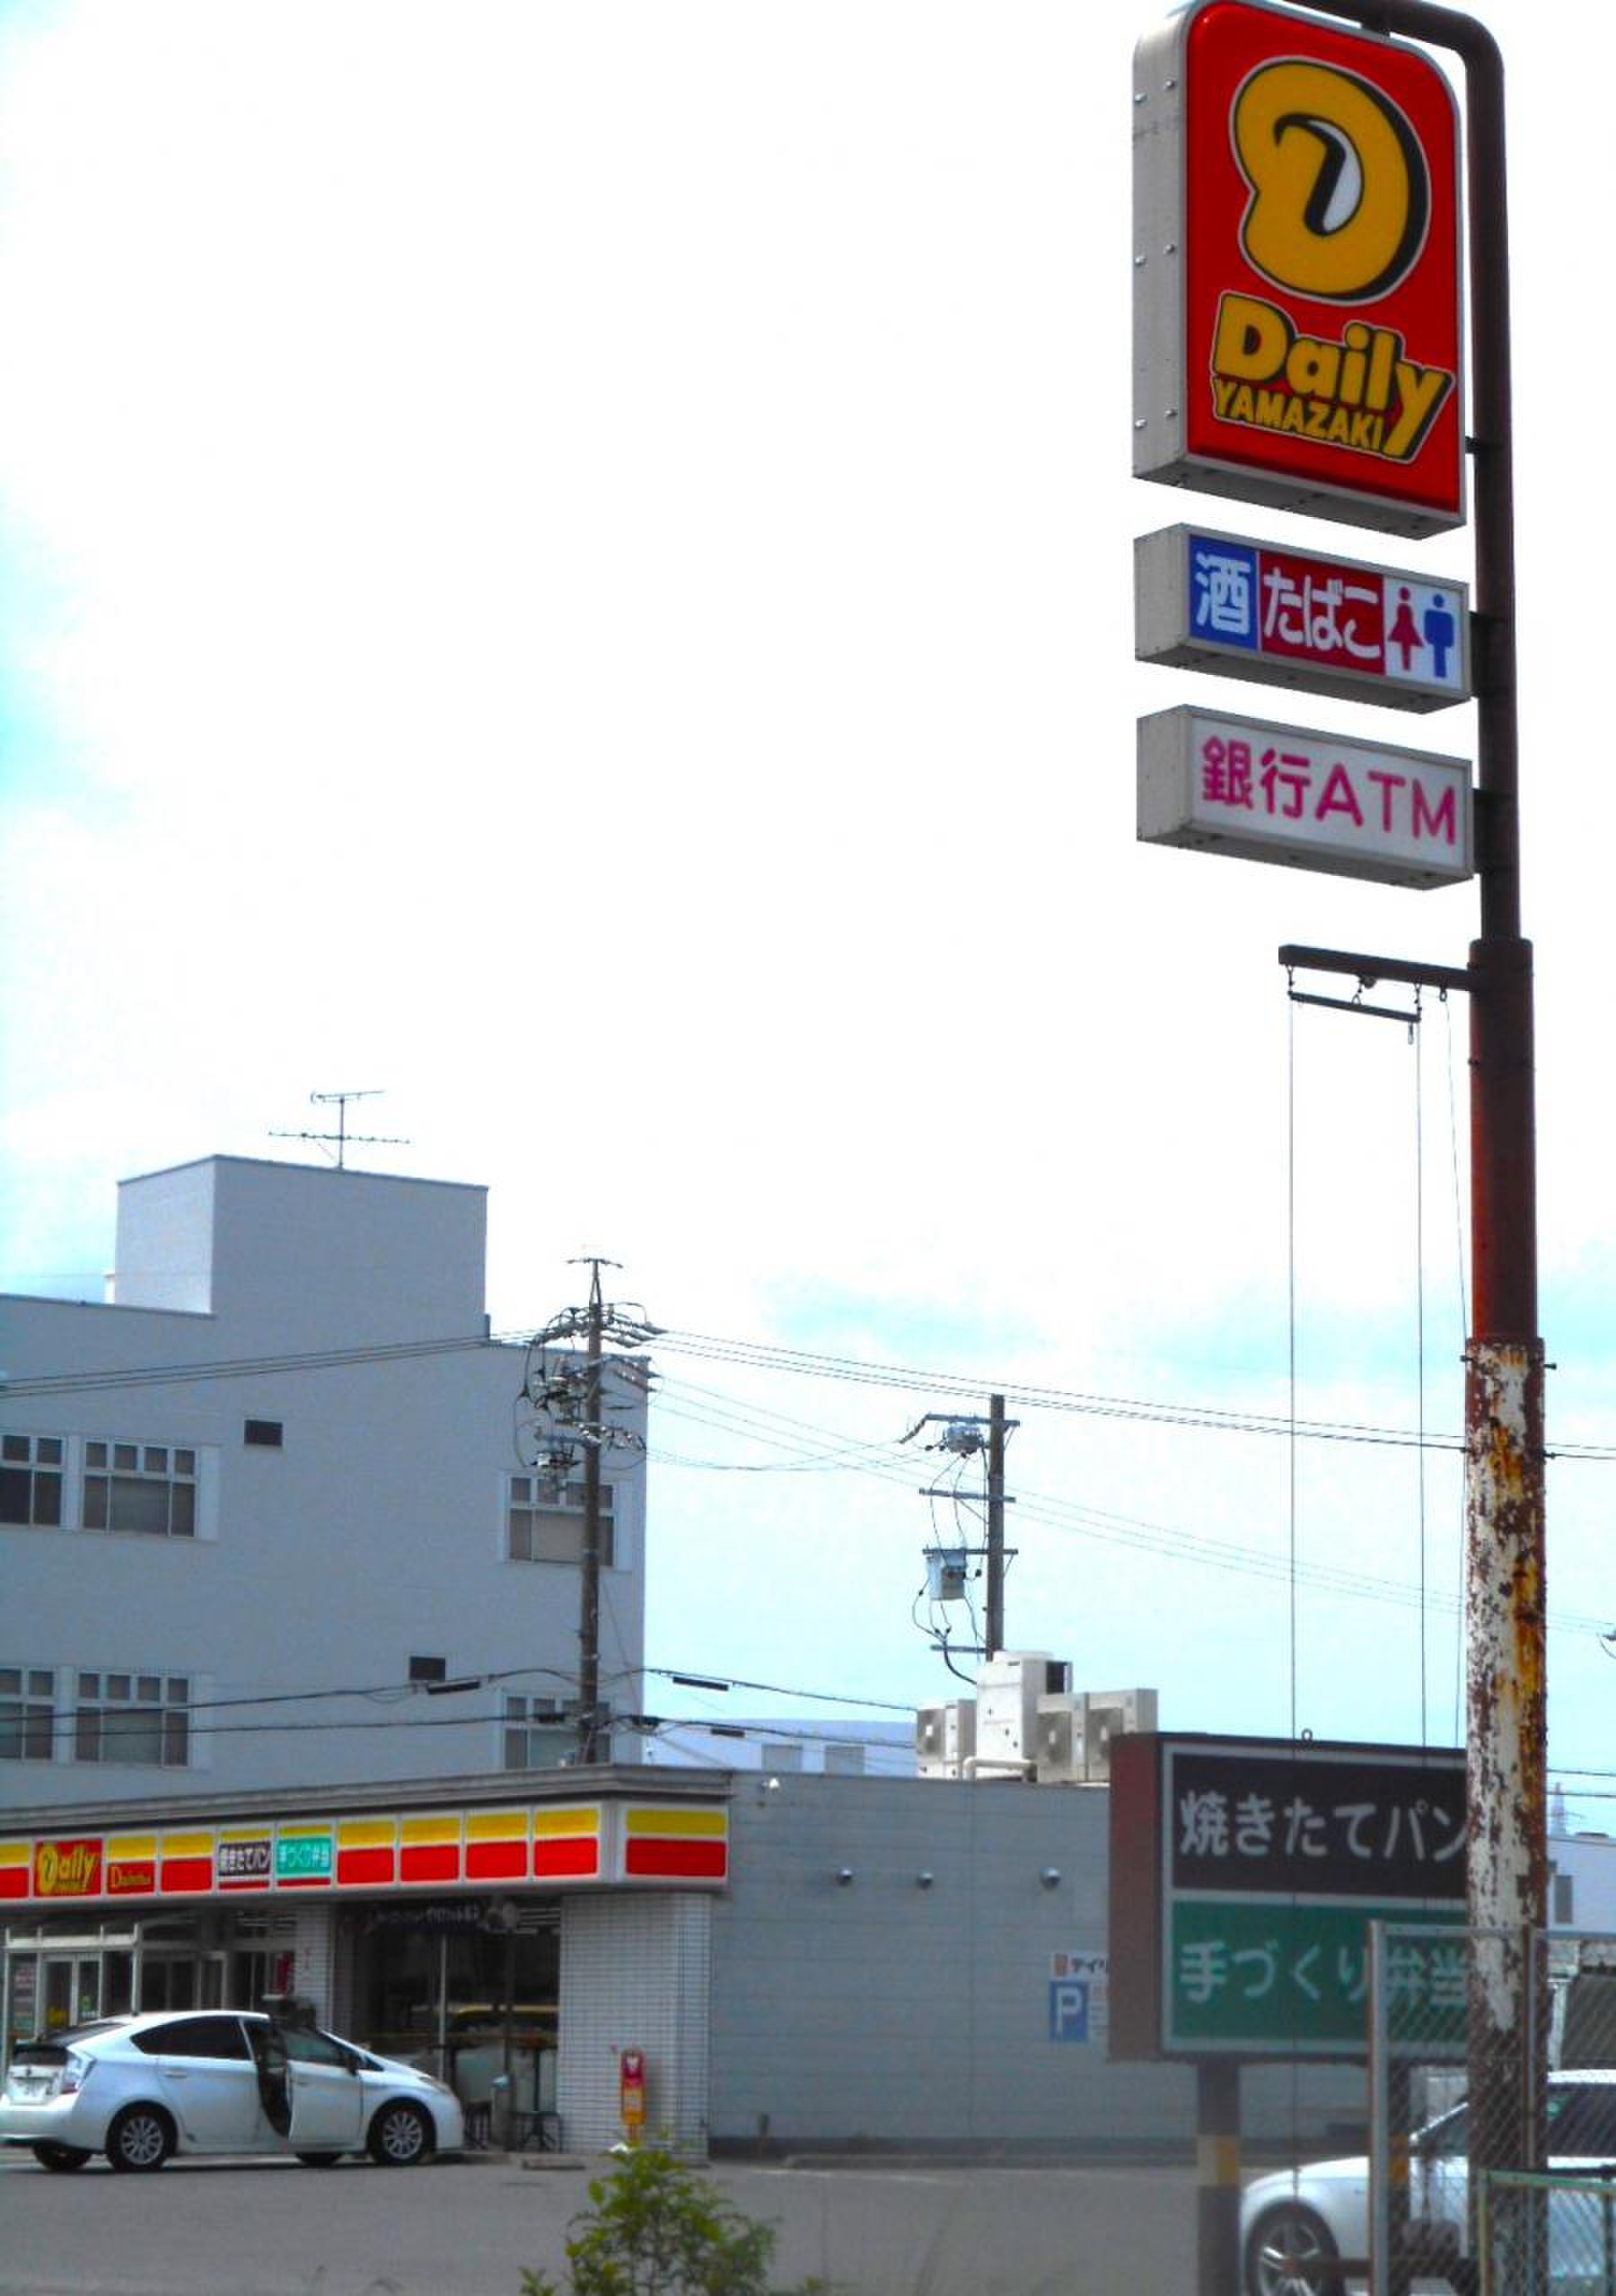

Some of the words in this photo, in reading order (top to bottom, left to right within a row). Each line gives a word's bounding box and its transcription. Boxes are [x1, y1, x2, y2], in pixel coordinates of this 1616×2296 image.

[1230, 57, 1431, 306] D
[1212, 291, 1455, 462] Daily
[1214, 376, 1383, 451] YAMAZAKI
[1195, 551, 1251, 635] 酒
[1263, 566, 1381, 660] たばこ
[1200, 735, 1456, 846] 銀行ATM
[1179, 1790, 1468, 1863] 焼きたてパン
[1057, 1986, 1083, 2031] P
